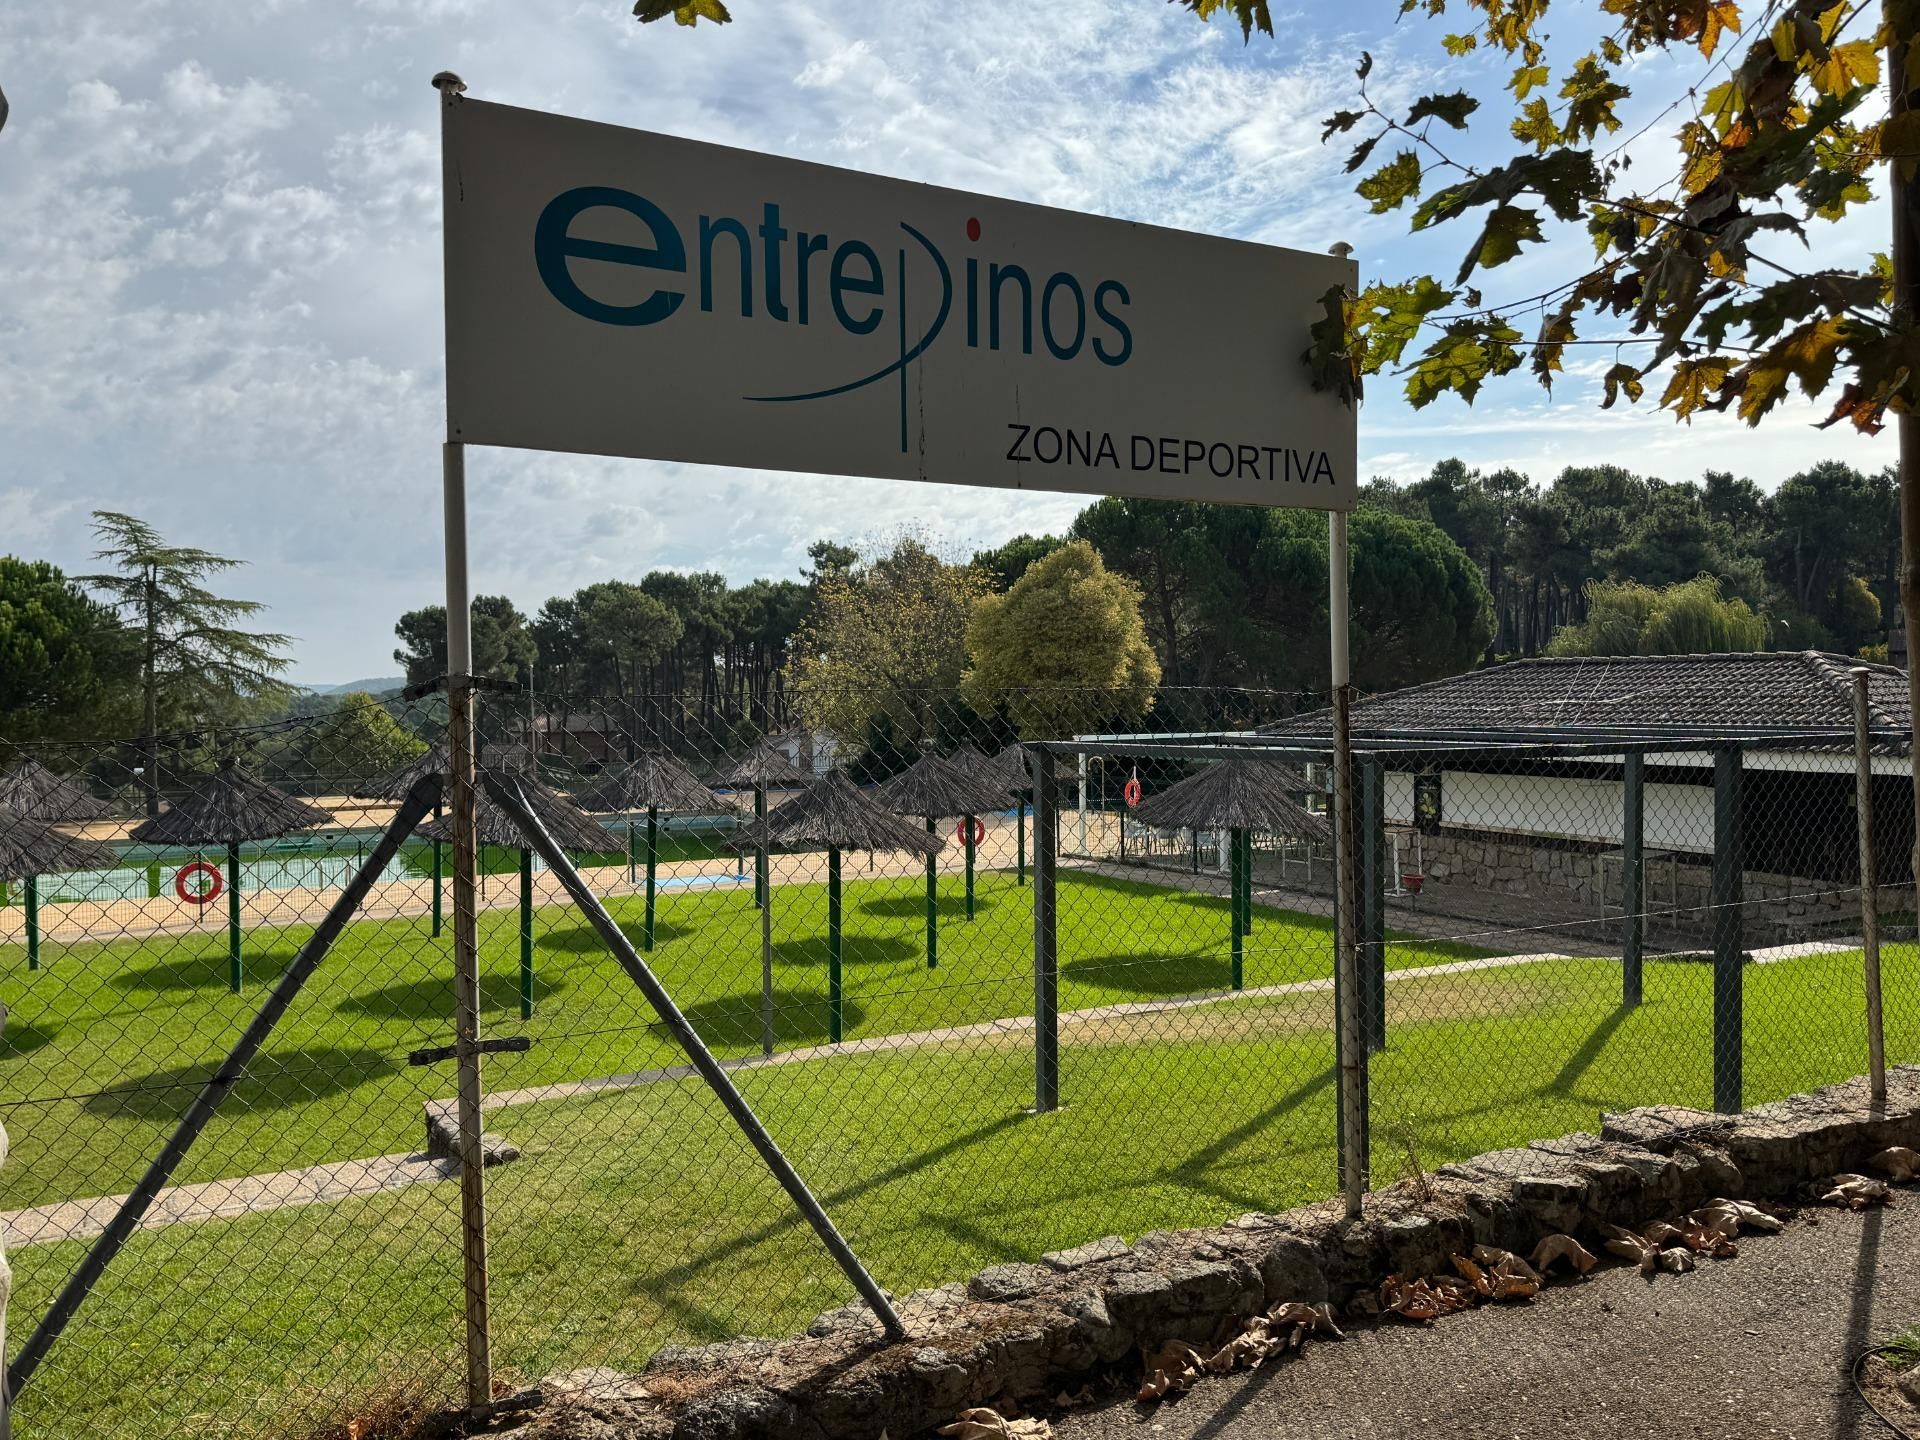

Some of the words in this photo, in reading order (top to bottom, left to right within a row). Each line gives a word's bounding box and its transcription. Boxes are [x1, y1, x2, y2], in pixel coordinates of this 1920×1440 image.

[534, 186, 1133, 453] entrepinos
[1006, 423, 1121, 470] ZONA
[1130, 435, 1336, 486] DEPORTIVA
